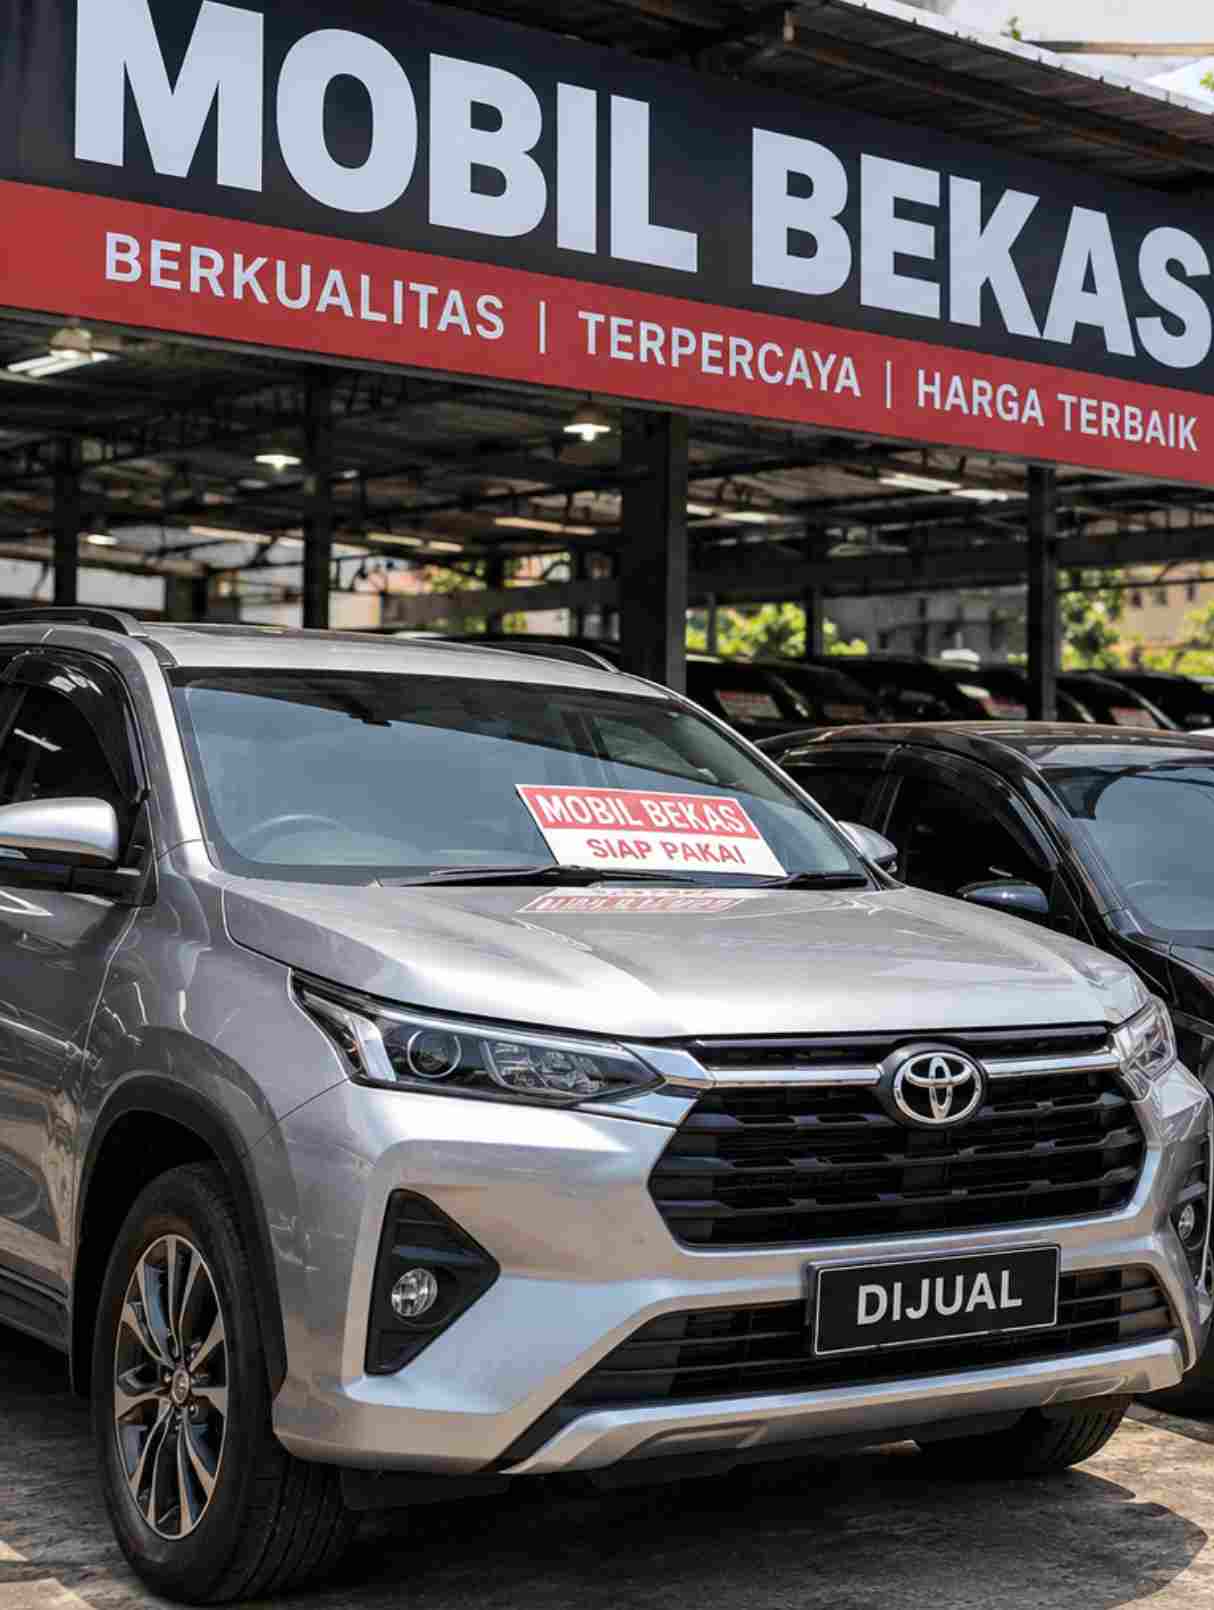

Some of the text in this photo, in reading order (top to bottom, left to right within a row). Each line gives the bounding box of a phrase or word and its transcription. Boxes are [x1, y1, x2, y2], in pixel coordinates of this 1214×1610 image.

[75, 0, 1212, 368] MOBIL BEKAS
[105, 231, 1199, 452] BERKUALITAS TERPERCAYA HARGA TERBAIK
[536, 795, 747, 833] MOBIL BEKAS
[587, 838, 746, 865] SIAP PAKAI
[856, 1269, 1023, 1326] DIJUAL
